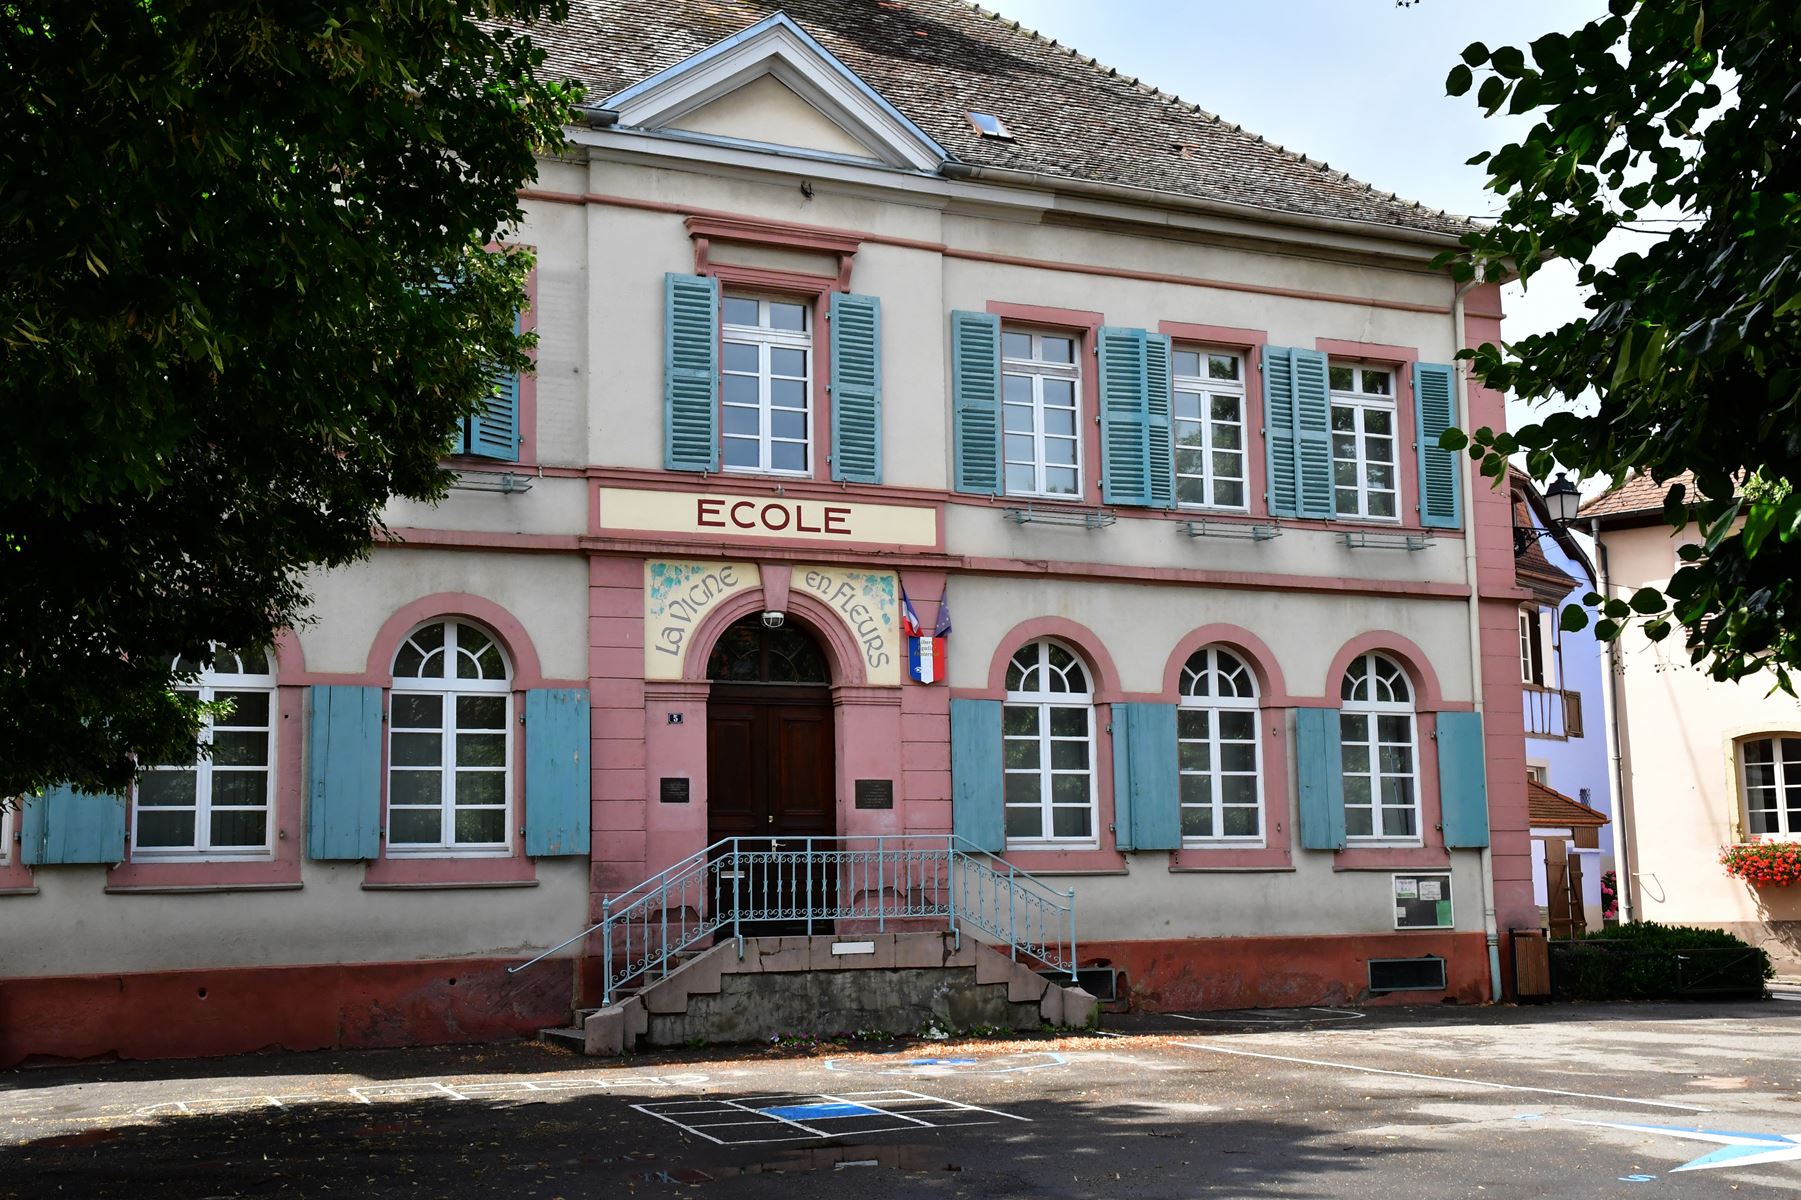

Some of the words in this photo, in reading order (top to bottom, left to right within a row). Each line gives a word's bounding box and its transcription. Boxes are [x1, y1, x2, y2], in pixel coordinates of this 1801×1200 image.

[697, 499, 851, 535] ECOLE
[828, 582, 890, 669] FLEURS
[673, 714, 679, 723] 5
